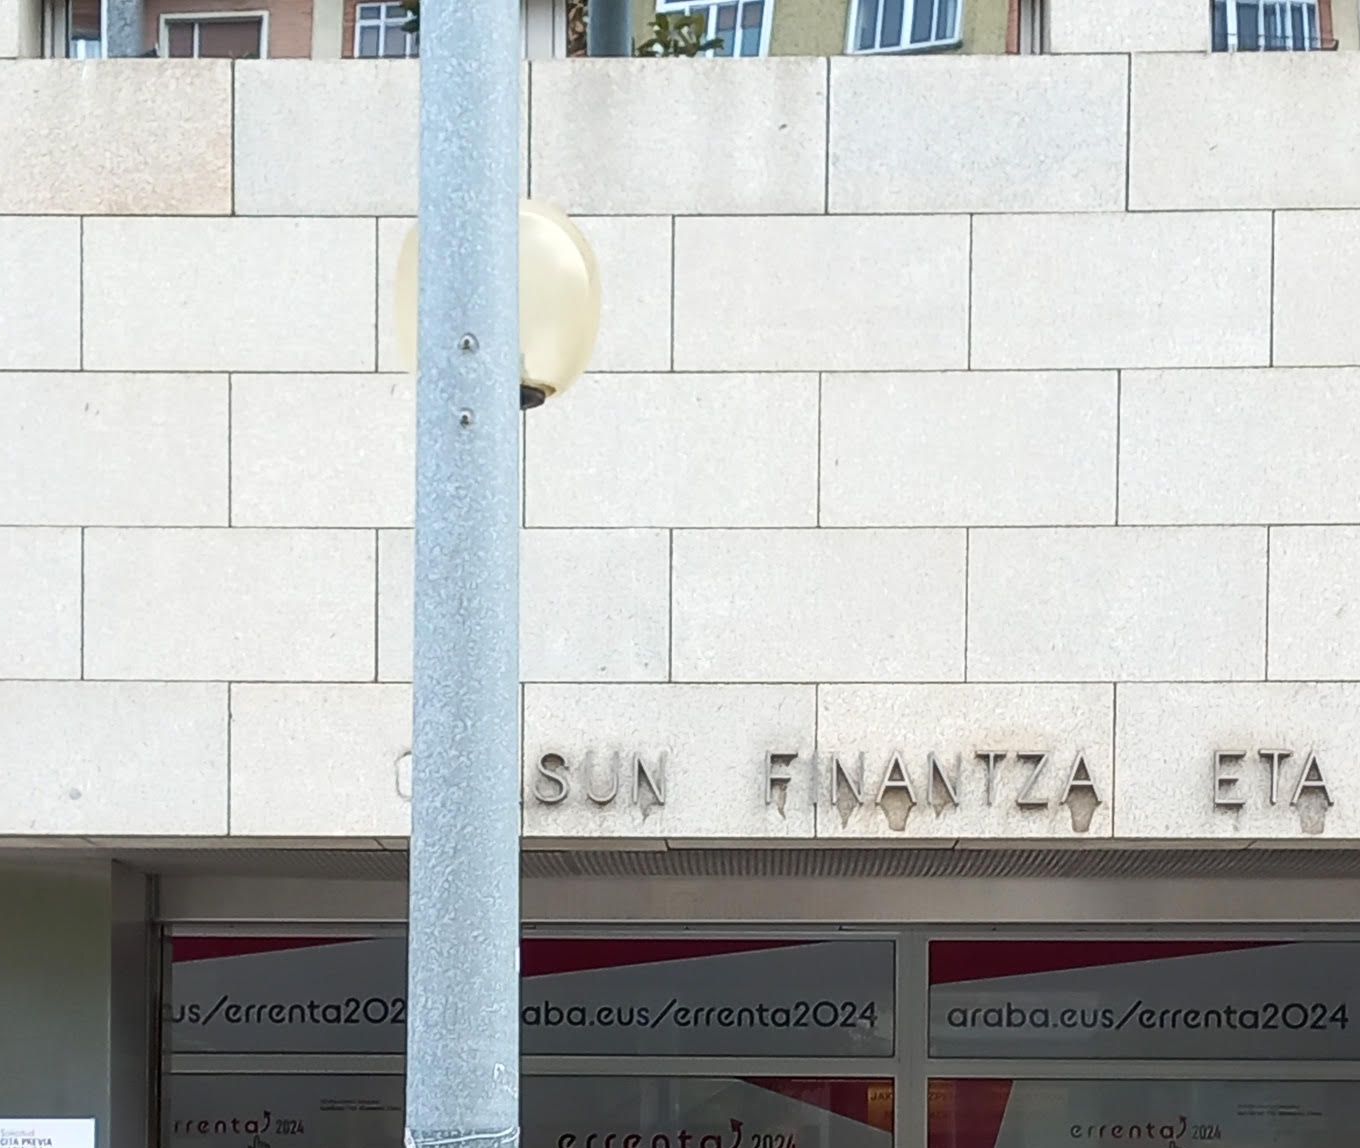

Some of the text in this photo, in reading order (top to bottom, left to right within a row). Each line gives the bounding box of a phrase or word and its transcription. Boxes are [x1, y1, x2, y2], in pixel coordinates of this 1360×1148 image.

[763, 749, 1101, 807] FINANTZA
[1212, 747, 1334, 807] ETA
[946, 999, 1350, 1032] araba.eus/errenta2024
[275, 1119, 305, 1135] 2024
[1069, 1122, 1222, 1141] errenta 2024
